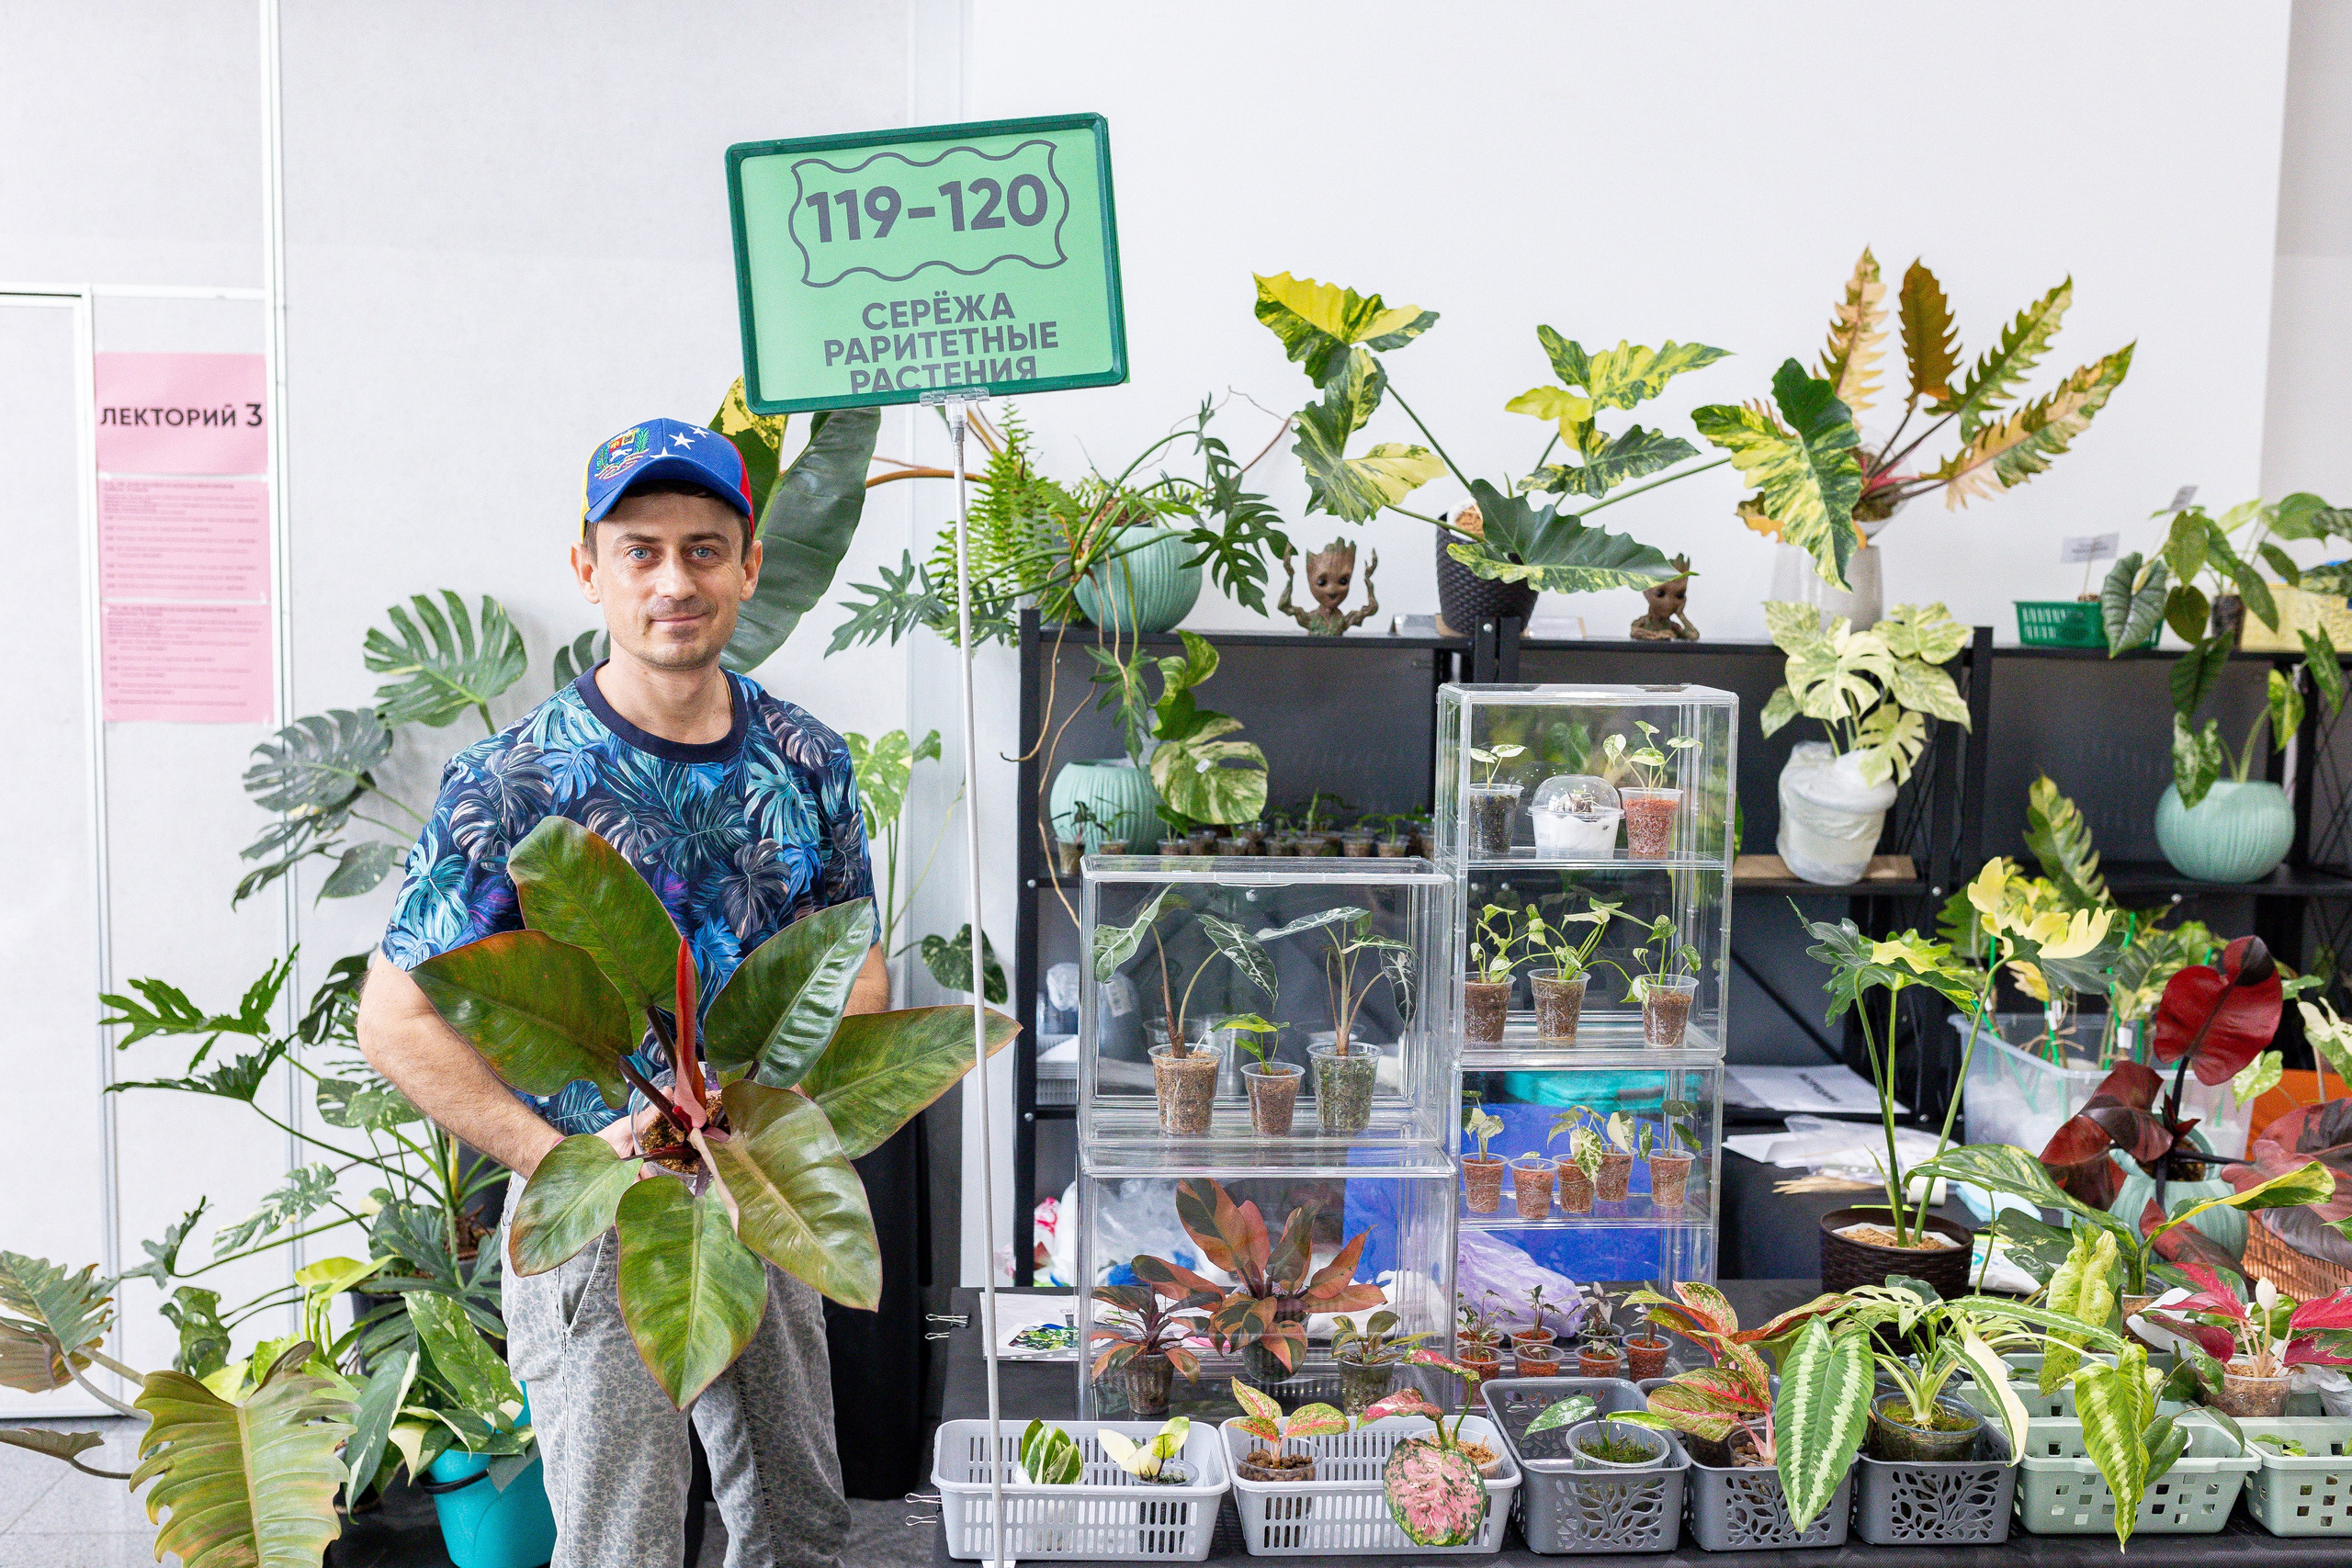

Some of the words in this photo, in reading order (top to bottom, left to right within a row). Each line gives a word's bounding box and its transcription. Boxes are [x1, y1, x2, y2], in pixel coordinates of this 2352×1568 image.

[862, 290, 1015, 331] СЕРЁЖА
[823, 321, 1059, 367] РАРИТЕТНЫЕ
[850, 355, 1037, 395] РАСТЕНИЯ
[101, 404, 236, 426] ЛЕКТОРИЙ
[245, 403, 263, 427] 3
